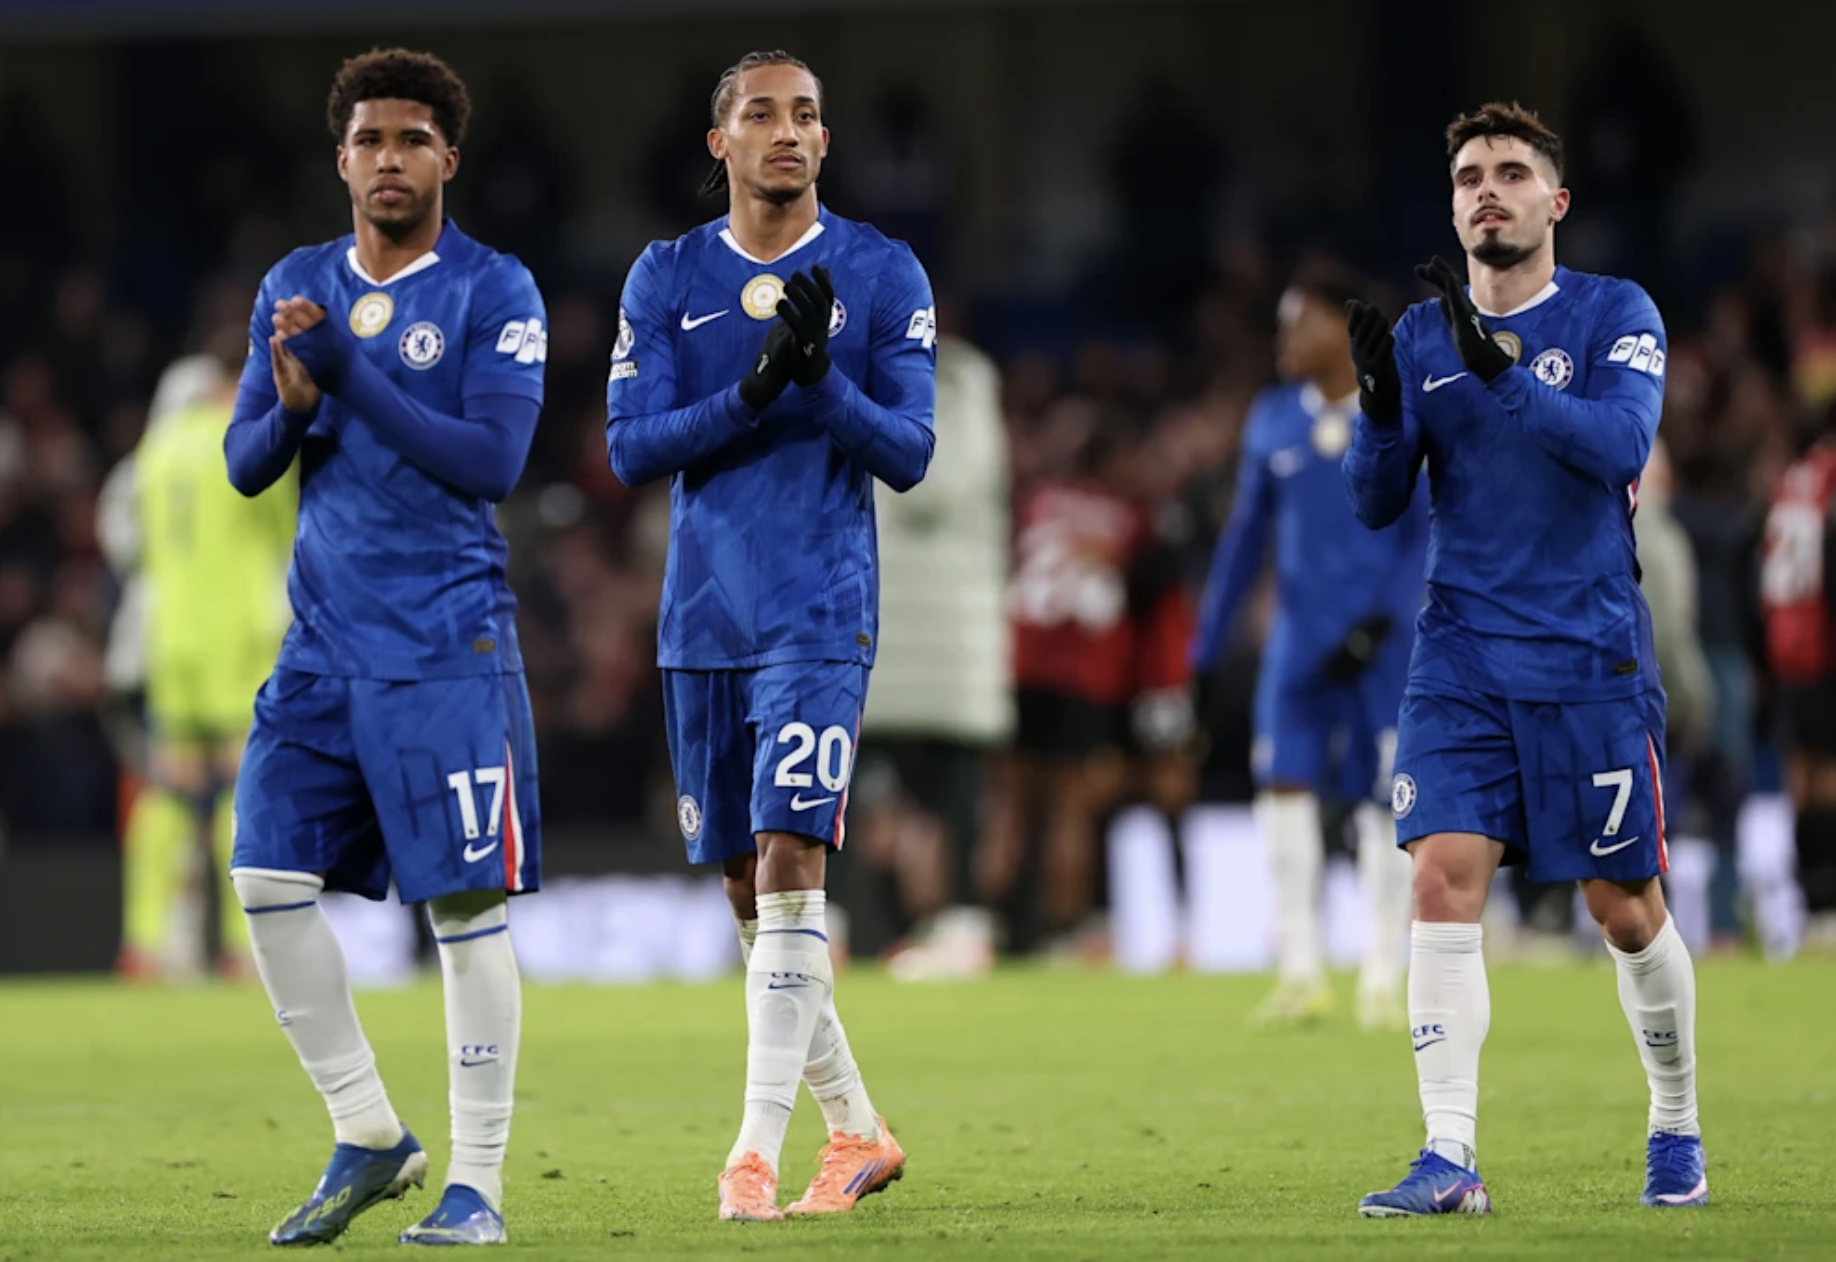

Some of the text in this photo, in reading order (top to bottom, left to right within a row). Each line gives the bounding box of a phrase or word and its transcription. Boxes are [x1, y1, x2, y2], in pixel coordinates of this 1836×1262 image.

[1610, 336, 1664, 372] FPT
[774, 721, 851, 792] 20
[447, 766, 506, 840] 17
[1592, 768, 1633, 836] 7
[461, 1045, 498, 1056] CFC
[1413, 1024, 1445, 1038] CFC
